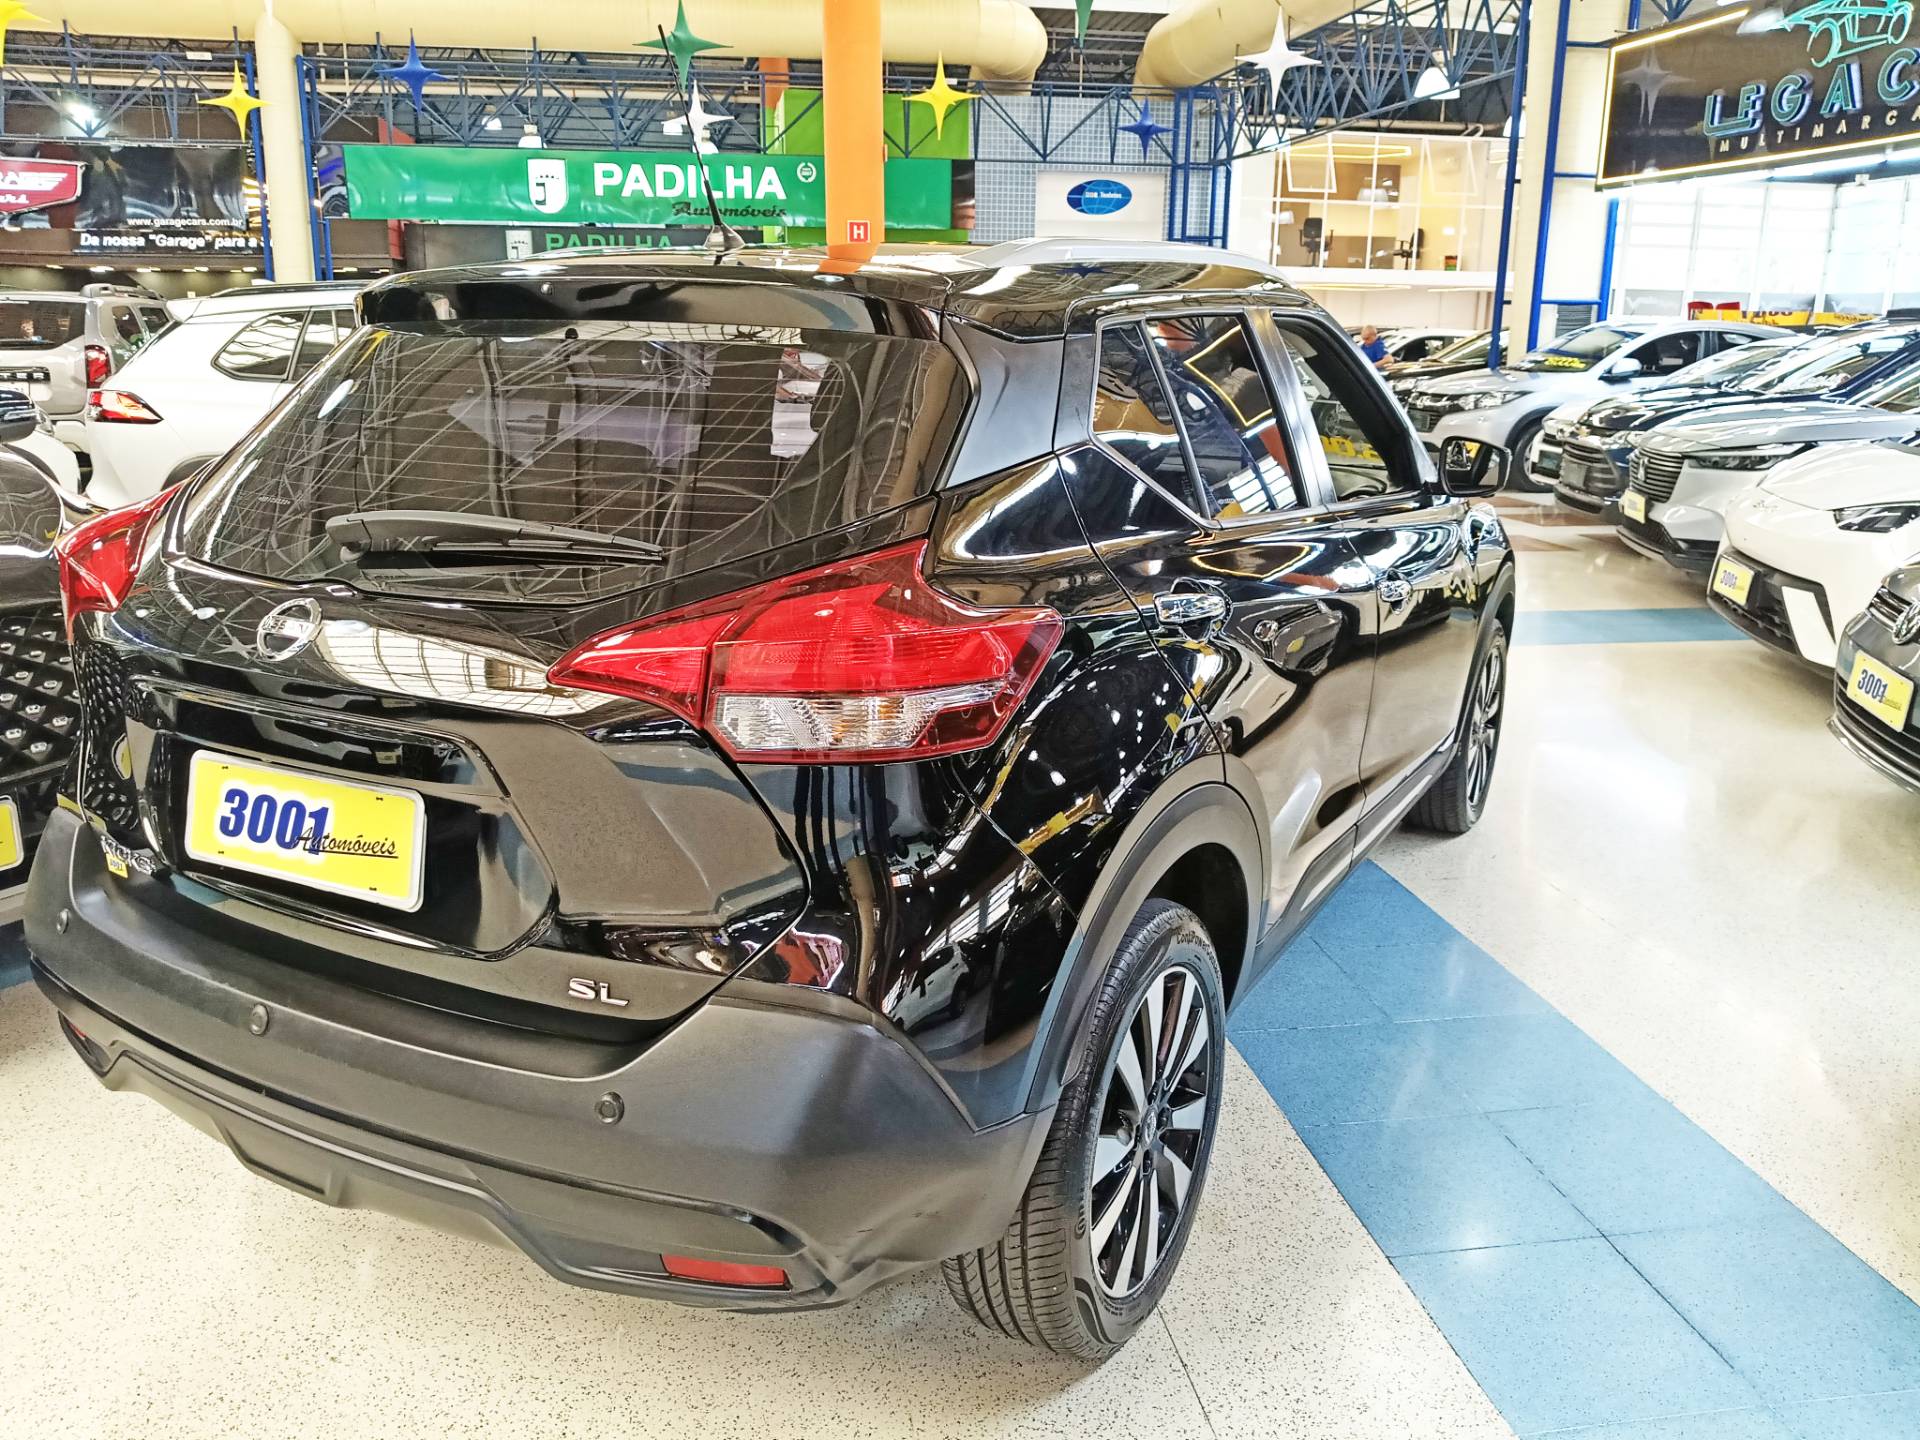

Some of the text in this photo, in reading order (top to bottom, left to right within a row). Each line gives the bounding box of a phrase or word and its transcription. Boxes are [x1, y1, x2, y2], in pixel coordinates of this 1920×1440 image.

[593, 162, 787, 200] PADILHA
[126, 217, 243, 229] www.garagecars.com.br
[852, 225, 865, 240] H
[102, 234, 146, 248] nossa
[149, 233, 212, 250] "Garage"
[214, 235, 247, 250] para
[248, 237, 258, 248] a
[1857, 668, 1888, 703] 3001
[219, 787, 329, 856] 3001
[292, 826, 397, 856] Automóveis
[567, 977, 629, 1007] SL
